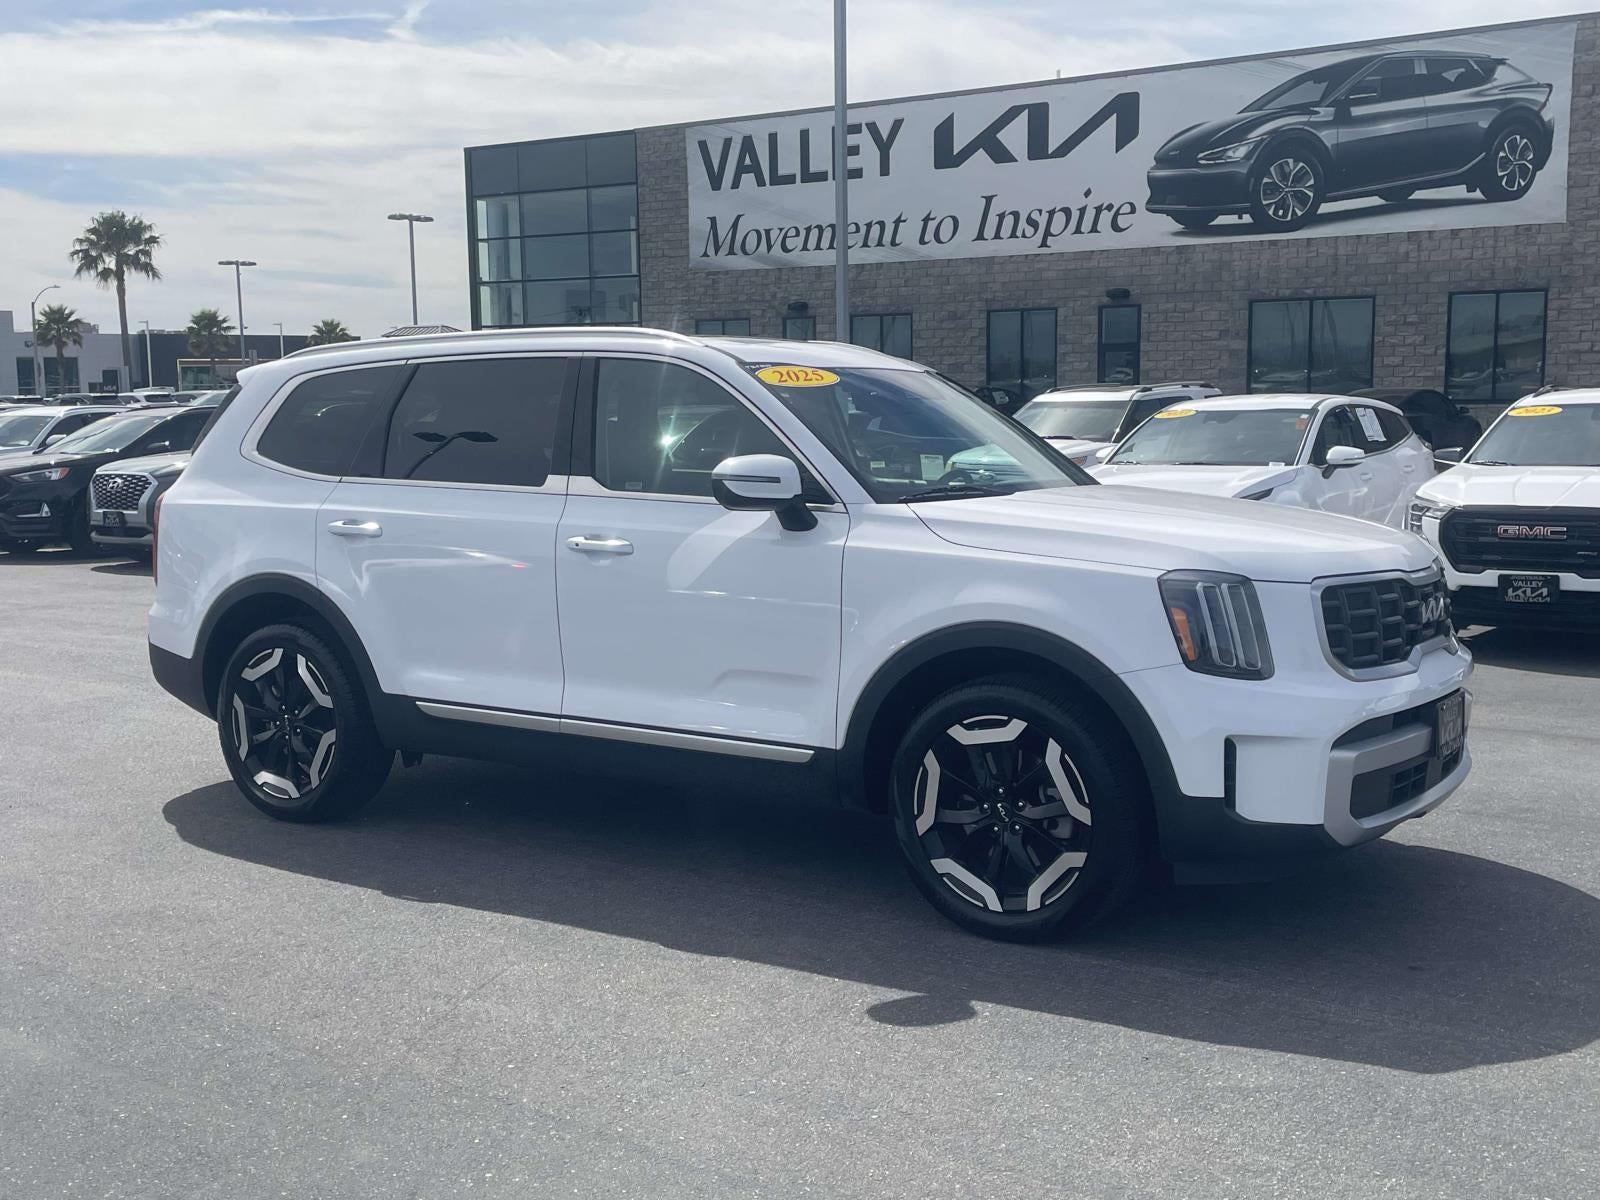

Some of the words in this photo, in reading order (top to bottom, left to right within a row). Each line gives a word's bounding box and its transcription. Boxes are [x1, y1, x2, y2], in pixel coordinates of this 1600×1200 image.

[698, 118, 904, 191] VALLEY
[934, 92, 1140, 169] KIA
[700, 211, 908, 258] Movement
[918, 208, 960, 246] to
[971, 187, 1137, 249] Inspire
[772, 369, 825, 383] 2025
[1497, 525, 1567, 539] GMC
[1512, 580, 1543, 588] VALLEY
[1507, 587, 1548, 598] KIA
